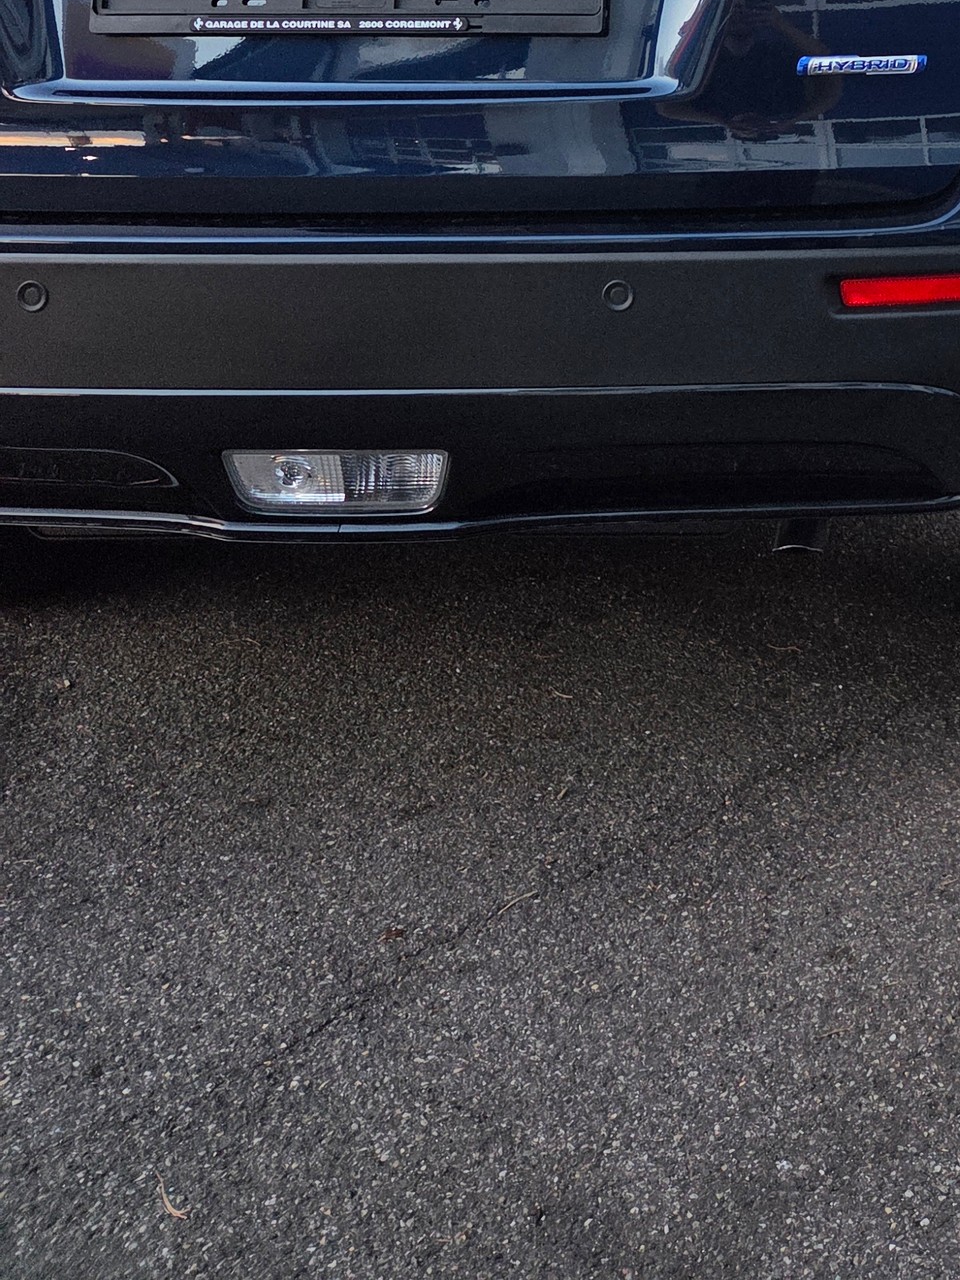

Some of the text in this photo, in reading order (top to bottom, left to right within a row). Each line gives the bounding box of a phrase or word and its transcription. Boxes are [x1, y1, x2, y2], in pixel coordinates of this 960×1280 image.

[205, 20, 451, 29] GARAGE DE LA COURTINE SA 2606 CORGEMONT
[816, 58, 909, 72] HYBRID
